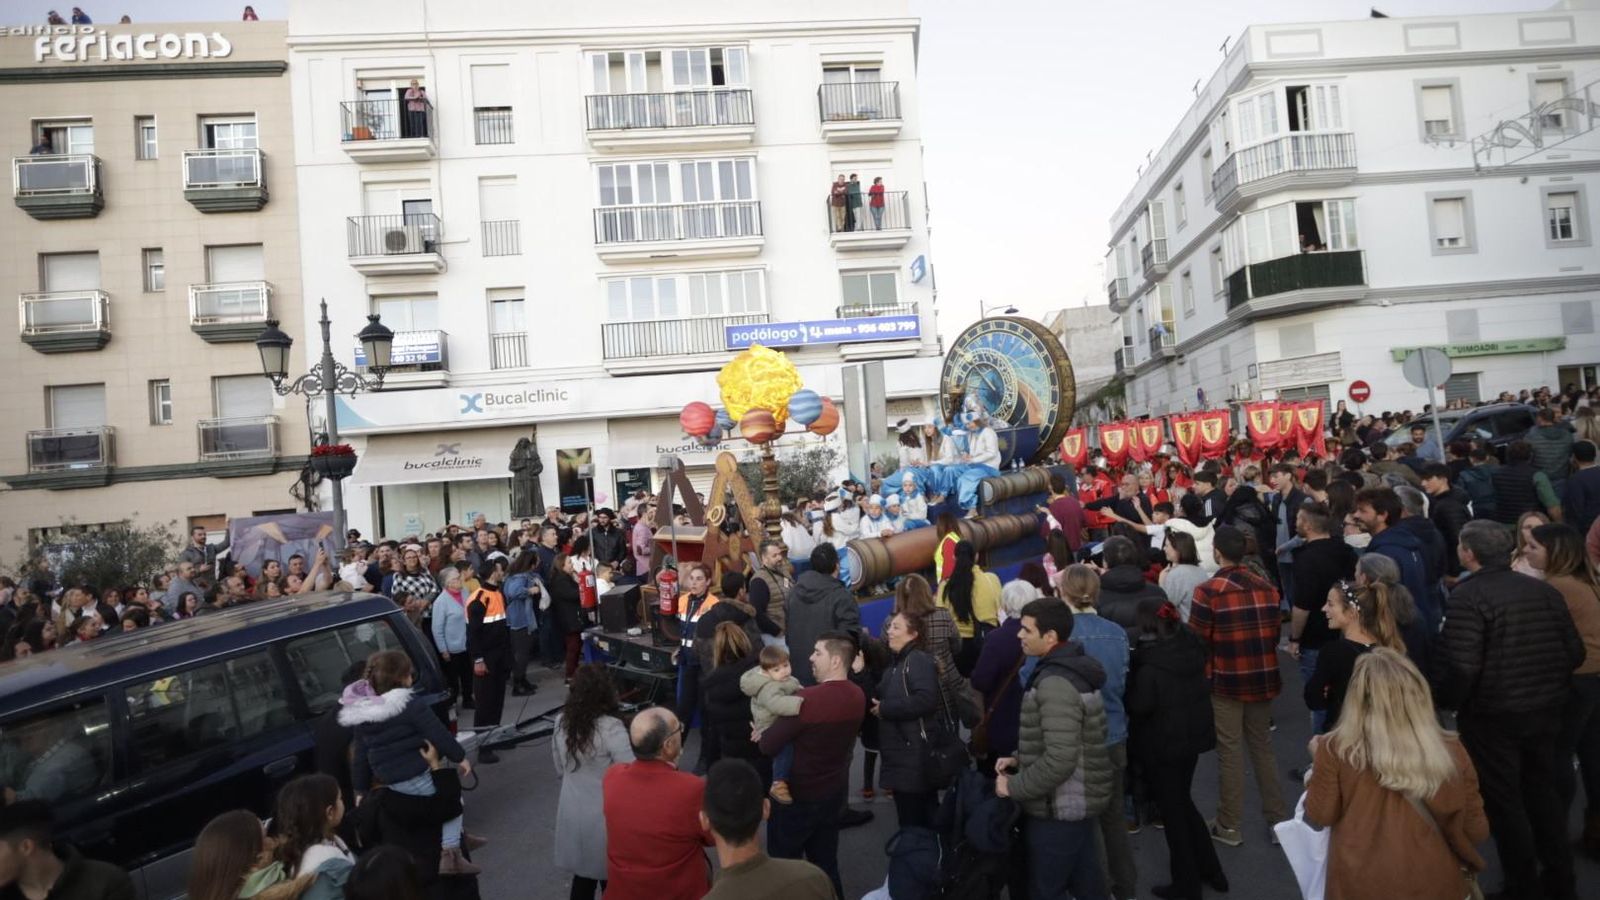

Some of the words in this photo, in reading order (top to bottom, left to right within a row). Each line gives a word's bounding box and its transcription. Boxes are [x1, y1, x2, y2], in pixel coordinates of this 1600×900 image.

[732, 326, 798, 344] podólogo
[897, 321, 916, 331] 799
[485, 389, 568, 406] Bucalclinic
[403, 456, 482, 470] bucalclinic
